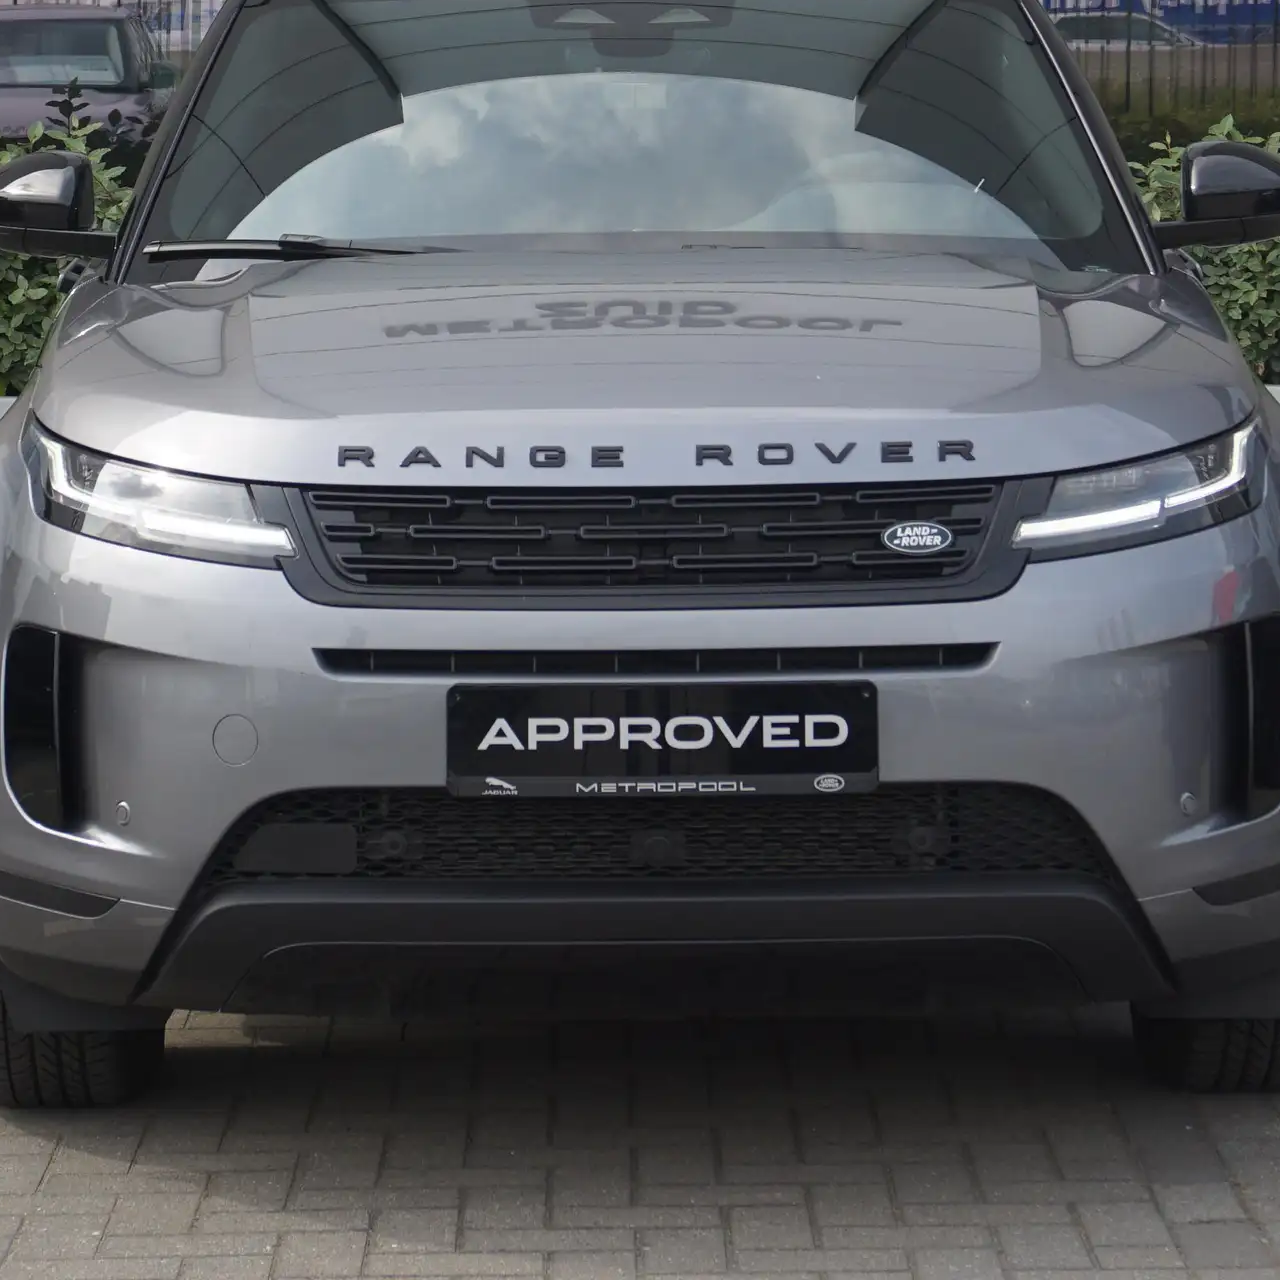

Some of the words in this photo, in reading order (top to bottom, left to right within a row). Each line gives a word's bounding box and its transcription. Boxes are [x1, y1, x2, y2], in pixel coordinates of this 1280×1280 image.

[337, 445, 624, 468] RANGE
[695, 440, 976, 466] ROVER
[897, 527, 930, 537] LAND
[901, 536, 942, 547] ROVER
[477, 714, 849, 751] APPROVED
[576, 781, 756, 793] METROPOOL
